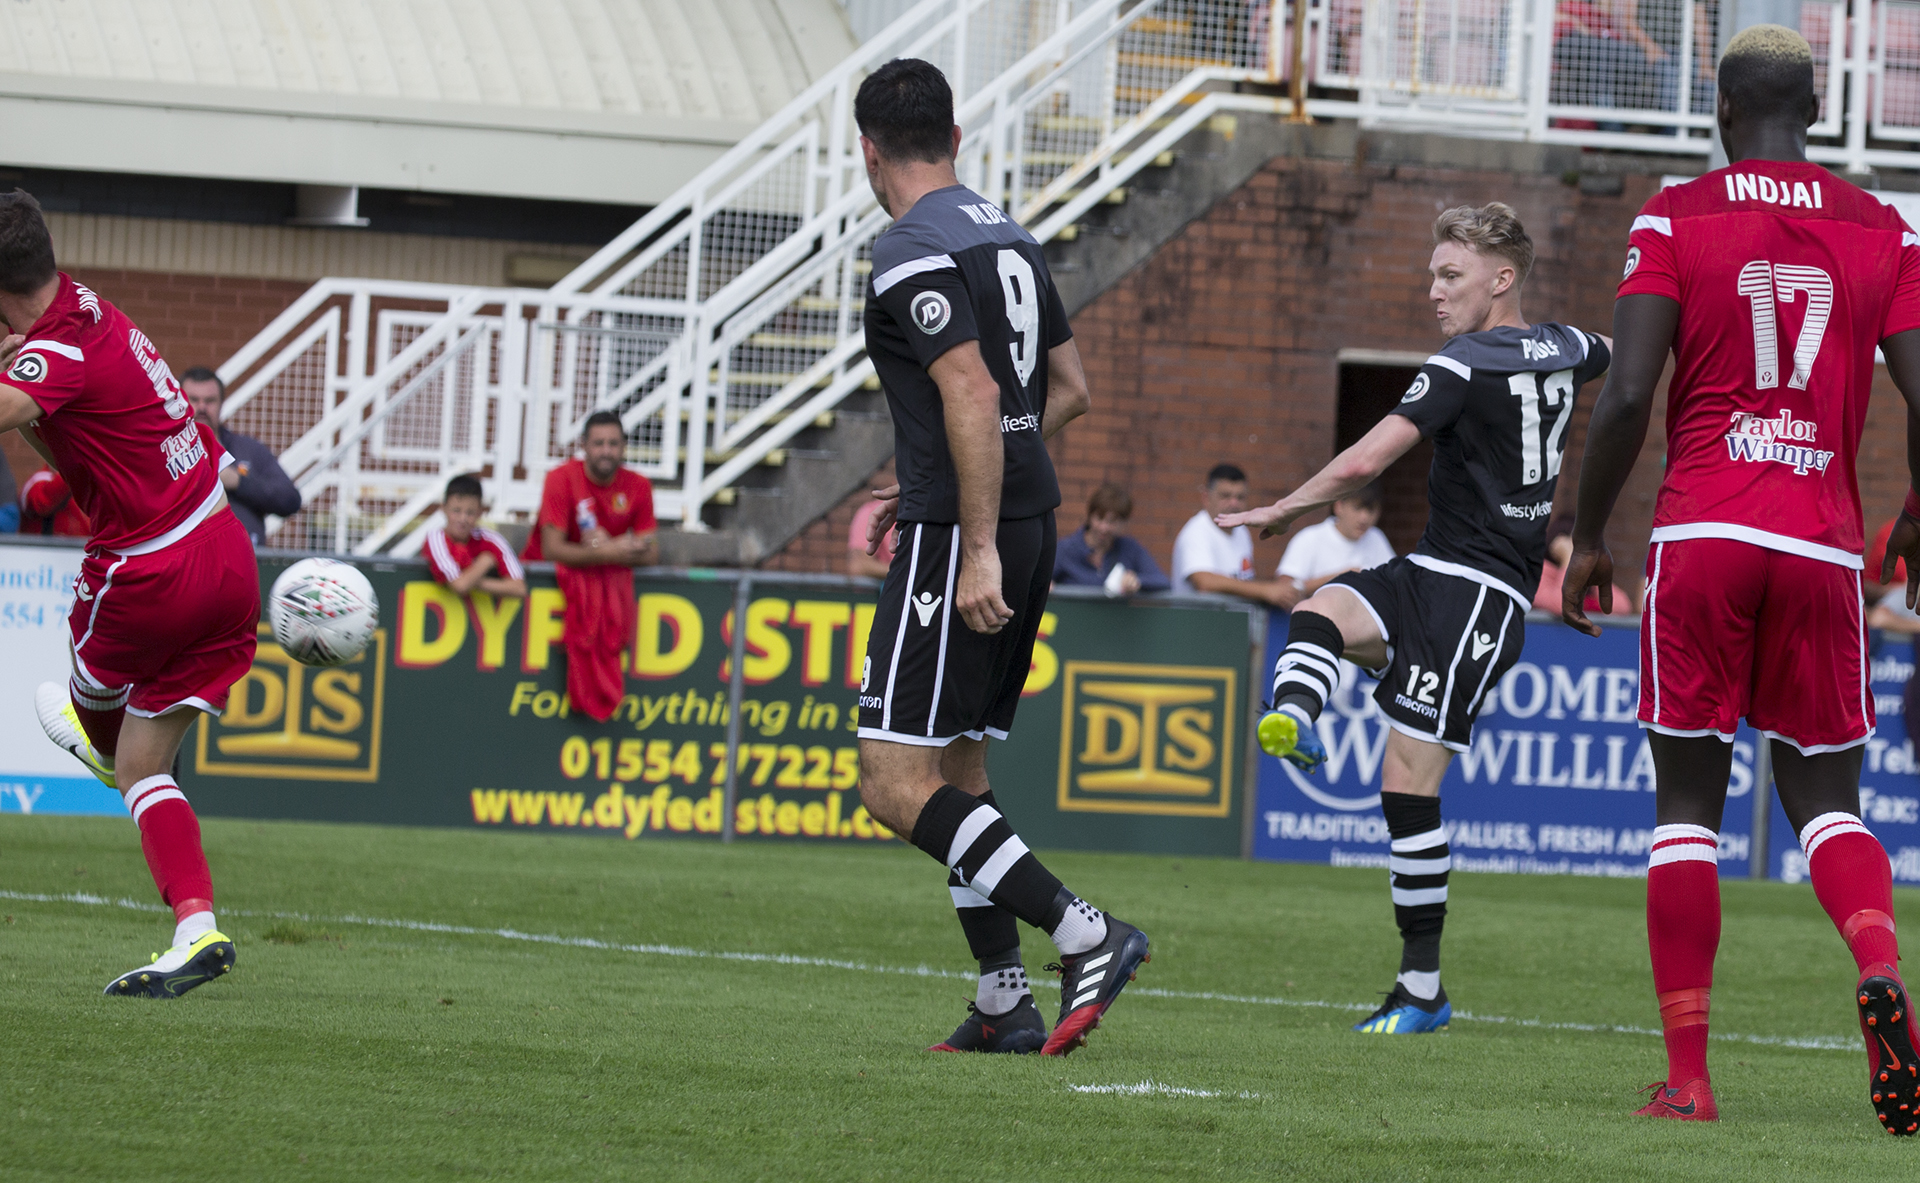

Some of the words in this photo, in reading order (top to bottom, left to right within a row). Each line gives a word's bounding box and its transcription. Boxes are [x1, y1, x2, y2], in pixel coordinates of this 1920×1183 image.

[1725, 173, 1823, 209] INDJAI
[921, 301, 941, 326] JD
[997, 248, 1039, 388] 9
[1738, 260, 1834, 390] 17
[160, 417, 199, 462] Taylo
[1508, 368, 1573, 486] 12
[1730, 409, 1817, 444] Taylor
[166, 434, 208, 481] Wim
[1725, 434, 1834, 476] Wimpey
[396, 580, 704, 682] DYFD
[1395, 693, 1438, 720] macron
[1406, 664, 1440, 705] 12
[611, 689, 788, 737] nything
[797, 691, 839, 730] in
[560, 735, 702, 784] 01554
[709, 743, 861, 791] 77225
[1458, 729, 1755, 798] WILLIAS
